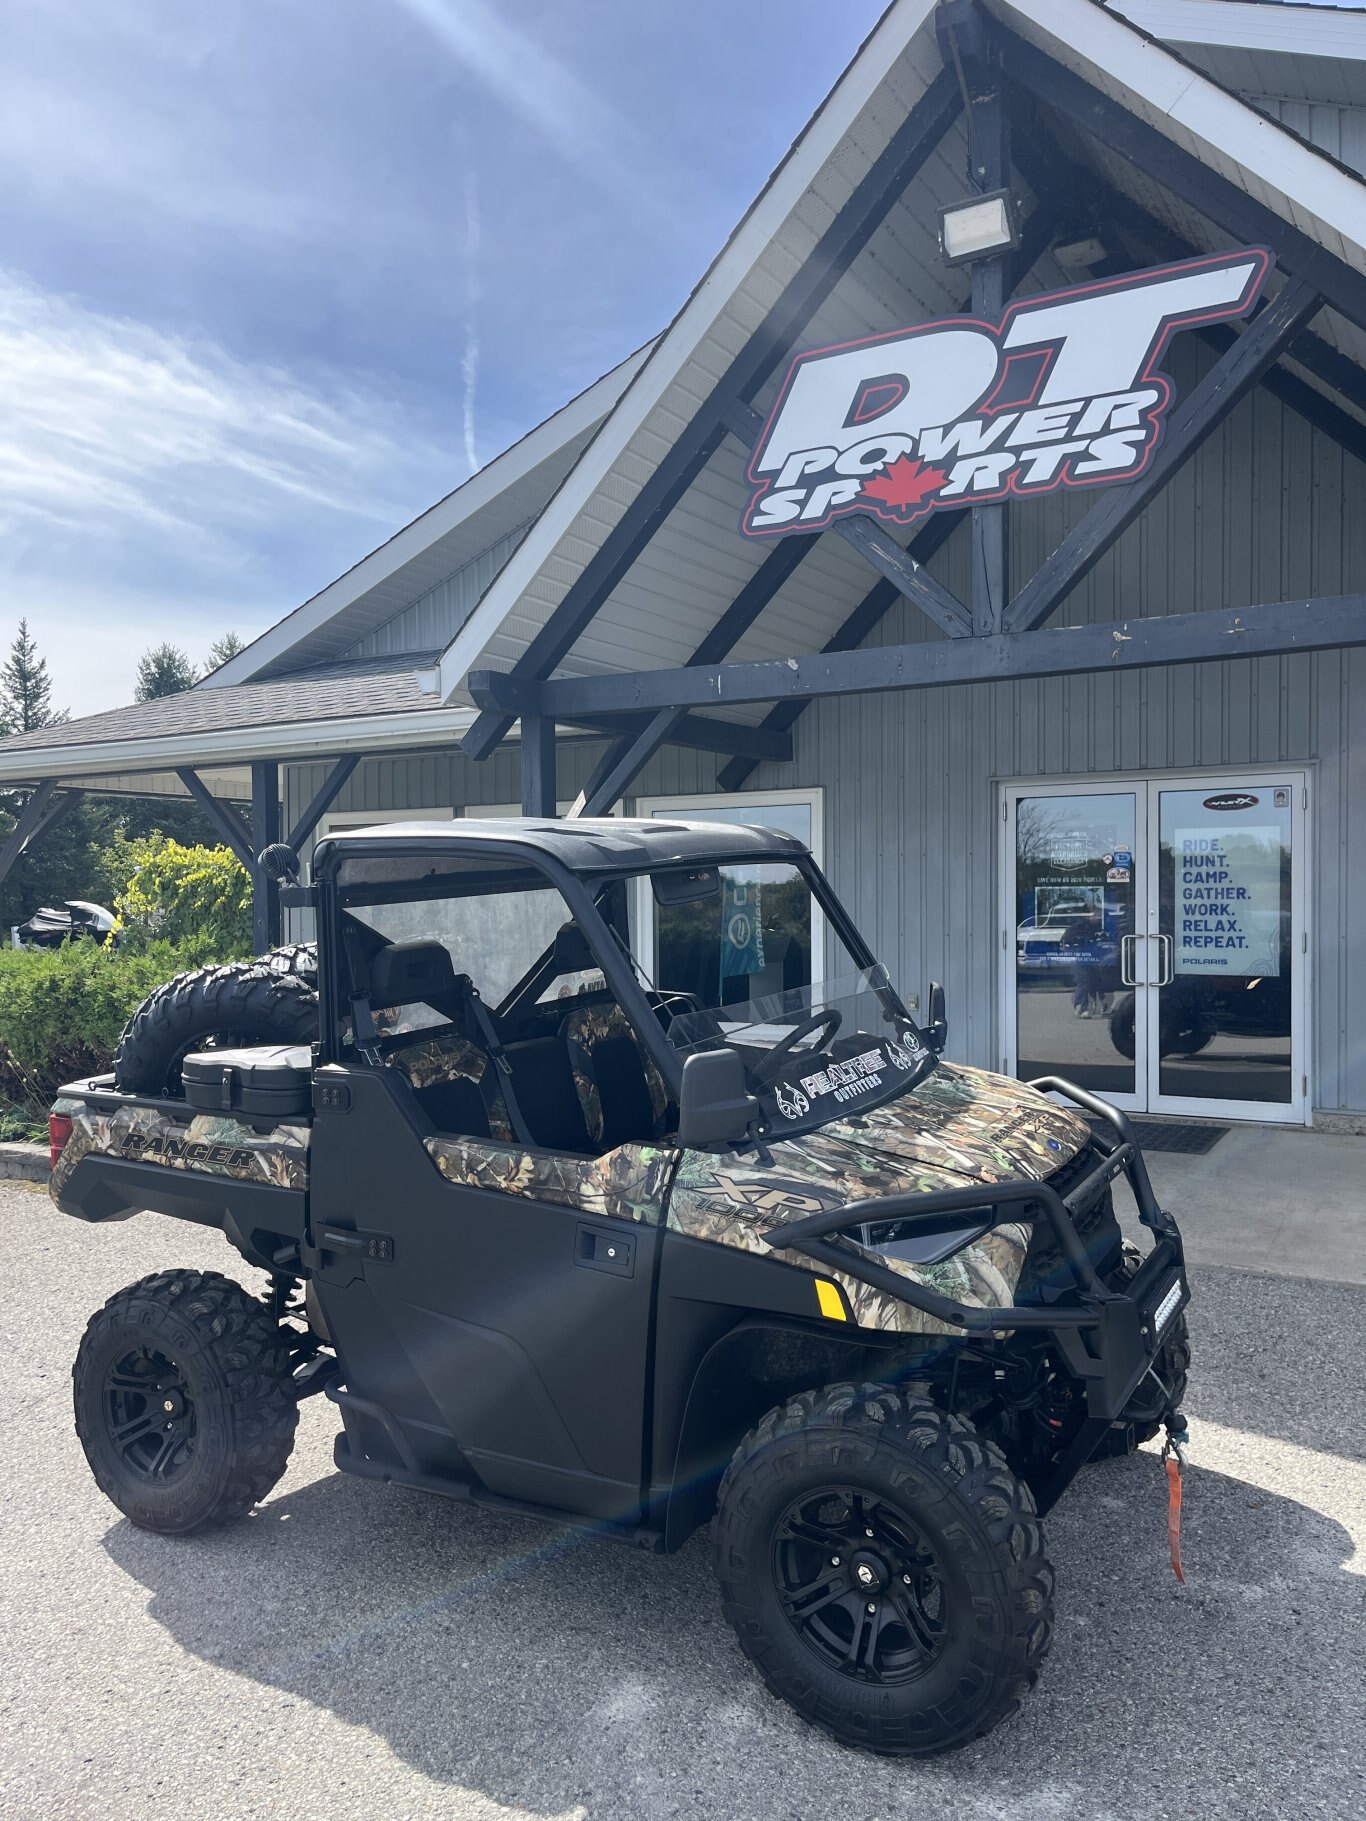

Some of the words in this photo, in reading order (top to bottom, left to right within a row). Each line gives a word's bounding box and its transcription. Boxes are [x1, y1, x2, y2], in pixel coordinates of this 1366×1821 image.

[757, 262, 1256, 472] DT
[774, 389, 1159, 488] POWER
[751, 430, 1147, 526] SPRTS
[1183, 839, 1224, 851] RIDE.
[1183, 855, 1230, 868] HUNT.
[1183, 871, 1233, 884] CAMP.
[1183, 887, 1251, 900] GATHER.
[1183, 903, 1236, 916] WORK.
[1183, 919, 1242, 932] RELAX.
[1183, 935, 1249, 949] REPEAT.
[800, 1048, 888, 1099] REALTREE
[834, 1073, 883, 1103] OUTFITTERS
[990, 1111, 1036, 1143] RANGER
[1029, 1113, 1052, 1133] XP
[120, 1133, 257, 1169] RANGER
[688, 1172, 825, 1212] XP
[695, 1198, 791, 1229] 1000
